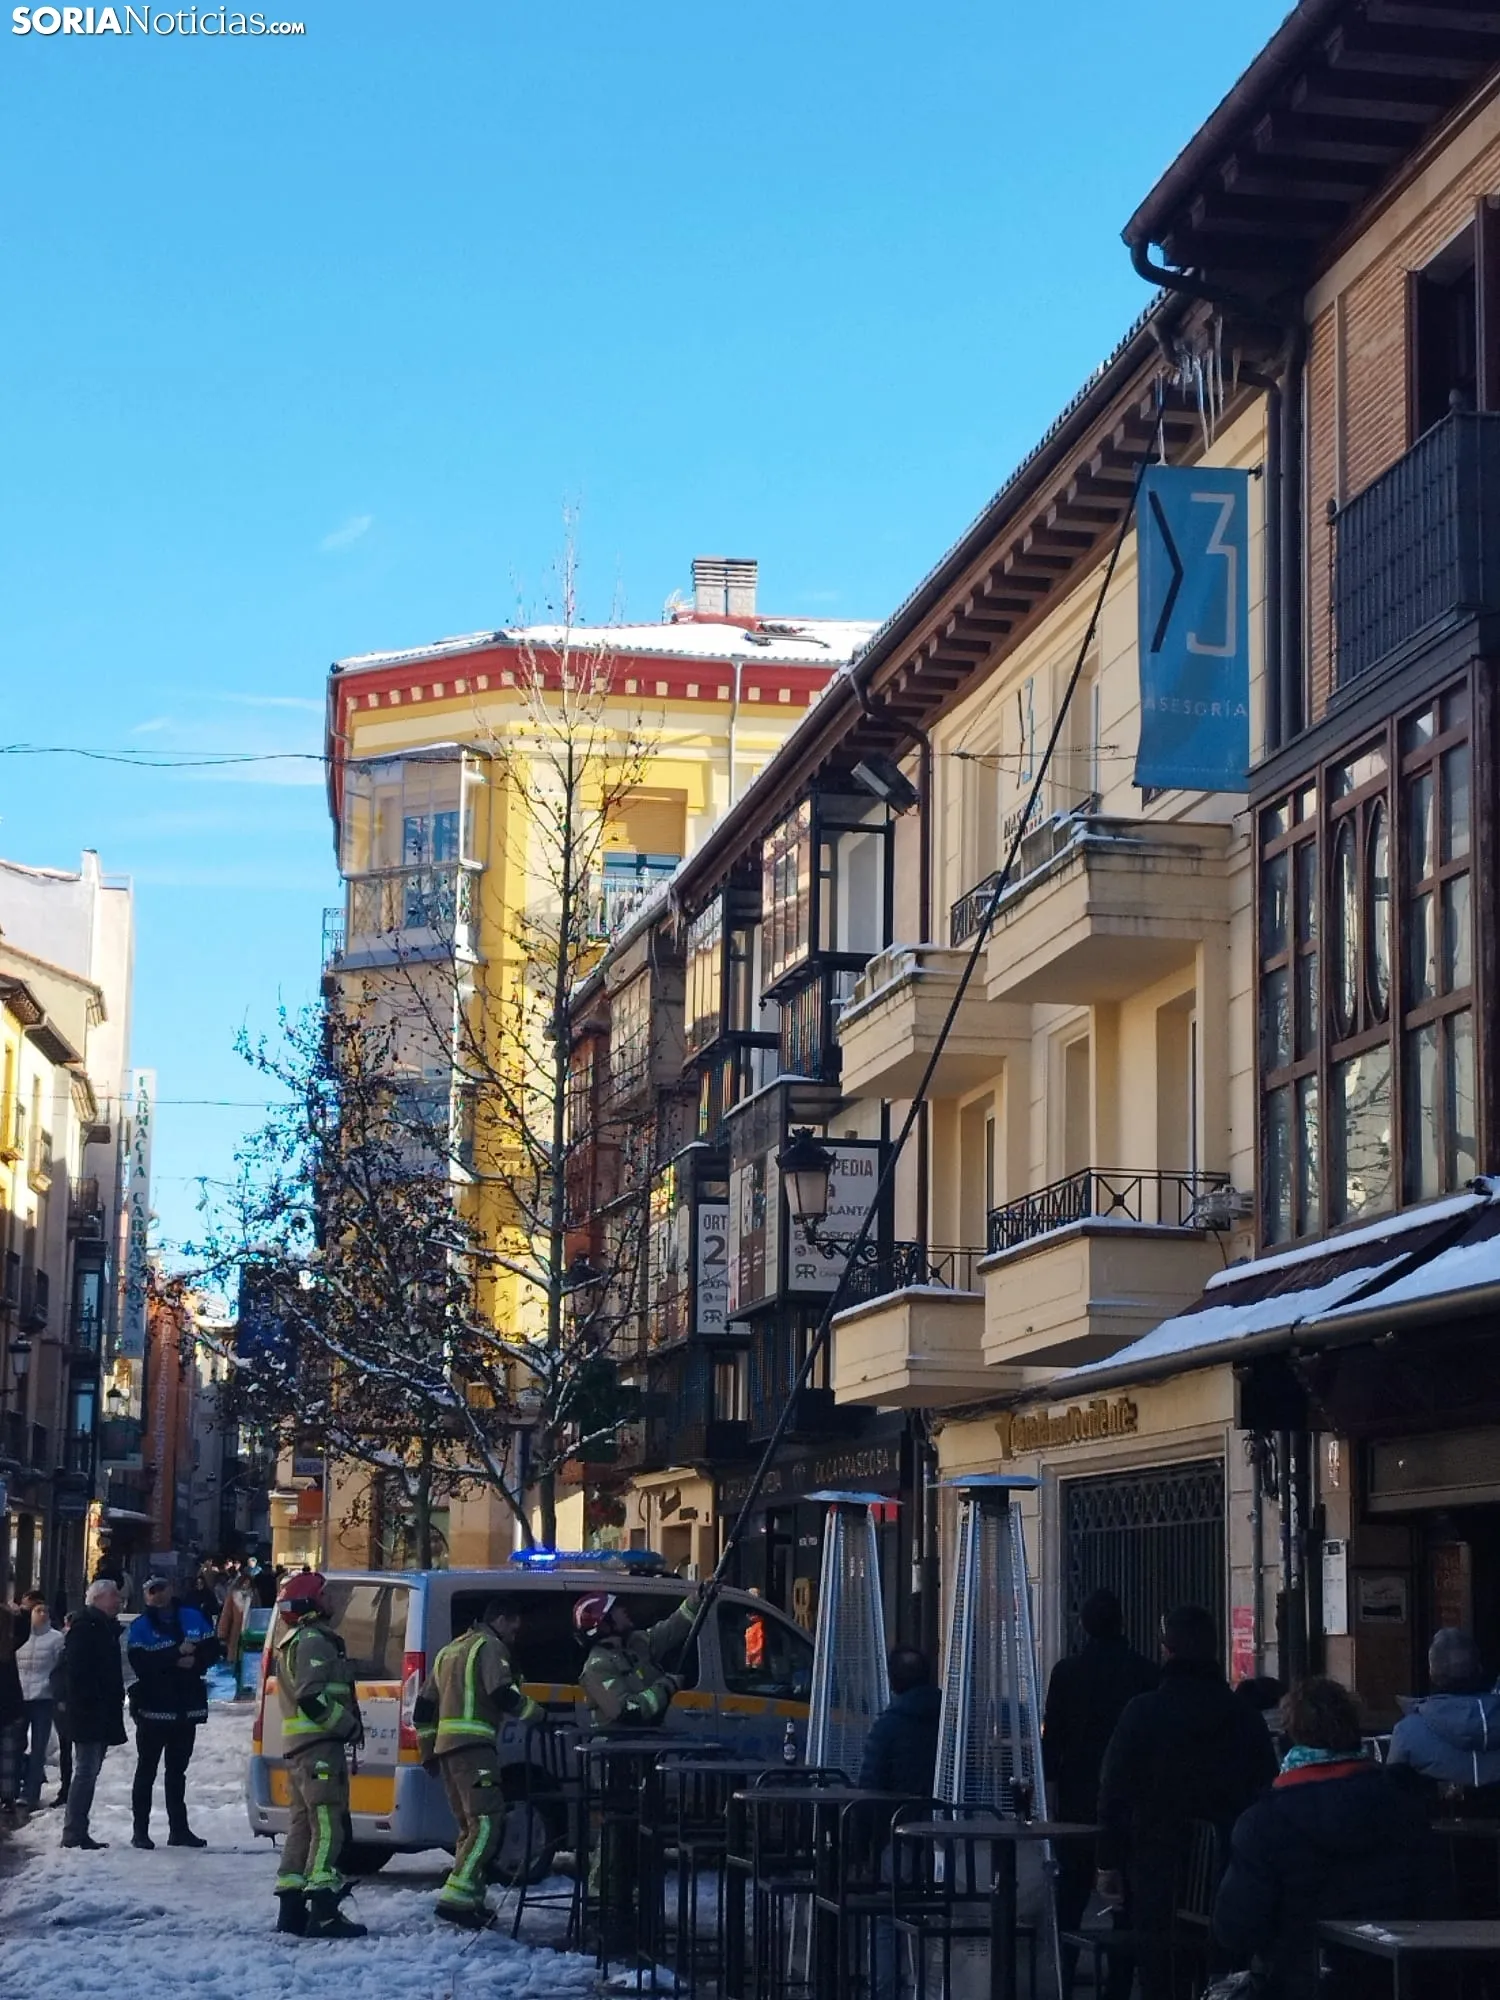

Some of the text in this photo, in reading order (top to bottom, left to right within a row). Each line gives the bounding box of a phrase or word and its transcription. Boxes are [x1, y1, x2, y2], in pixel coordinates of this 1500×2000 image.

[133, 1076, 148, 1178] FARMACIA
[833, 1159, 874, 1177] PEDIA
[829, 1205, 870, 1217] LANTA
